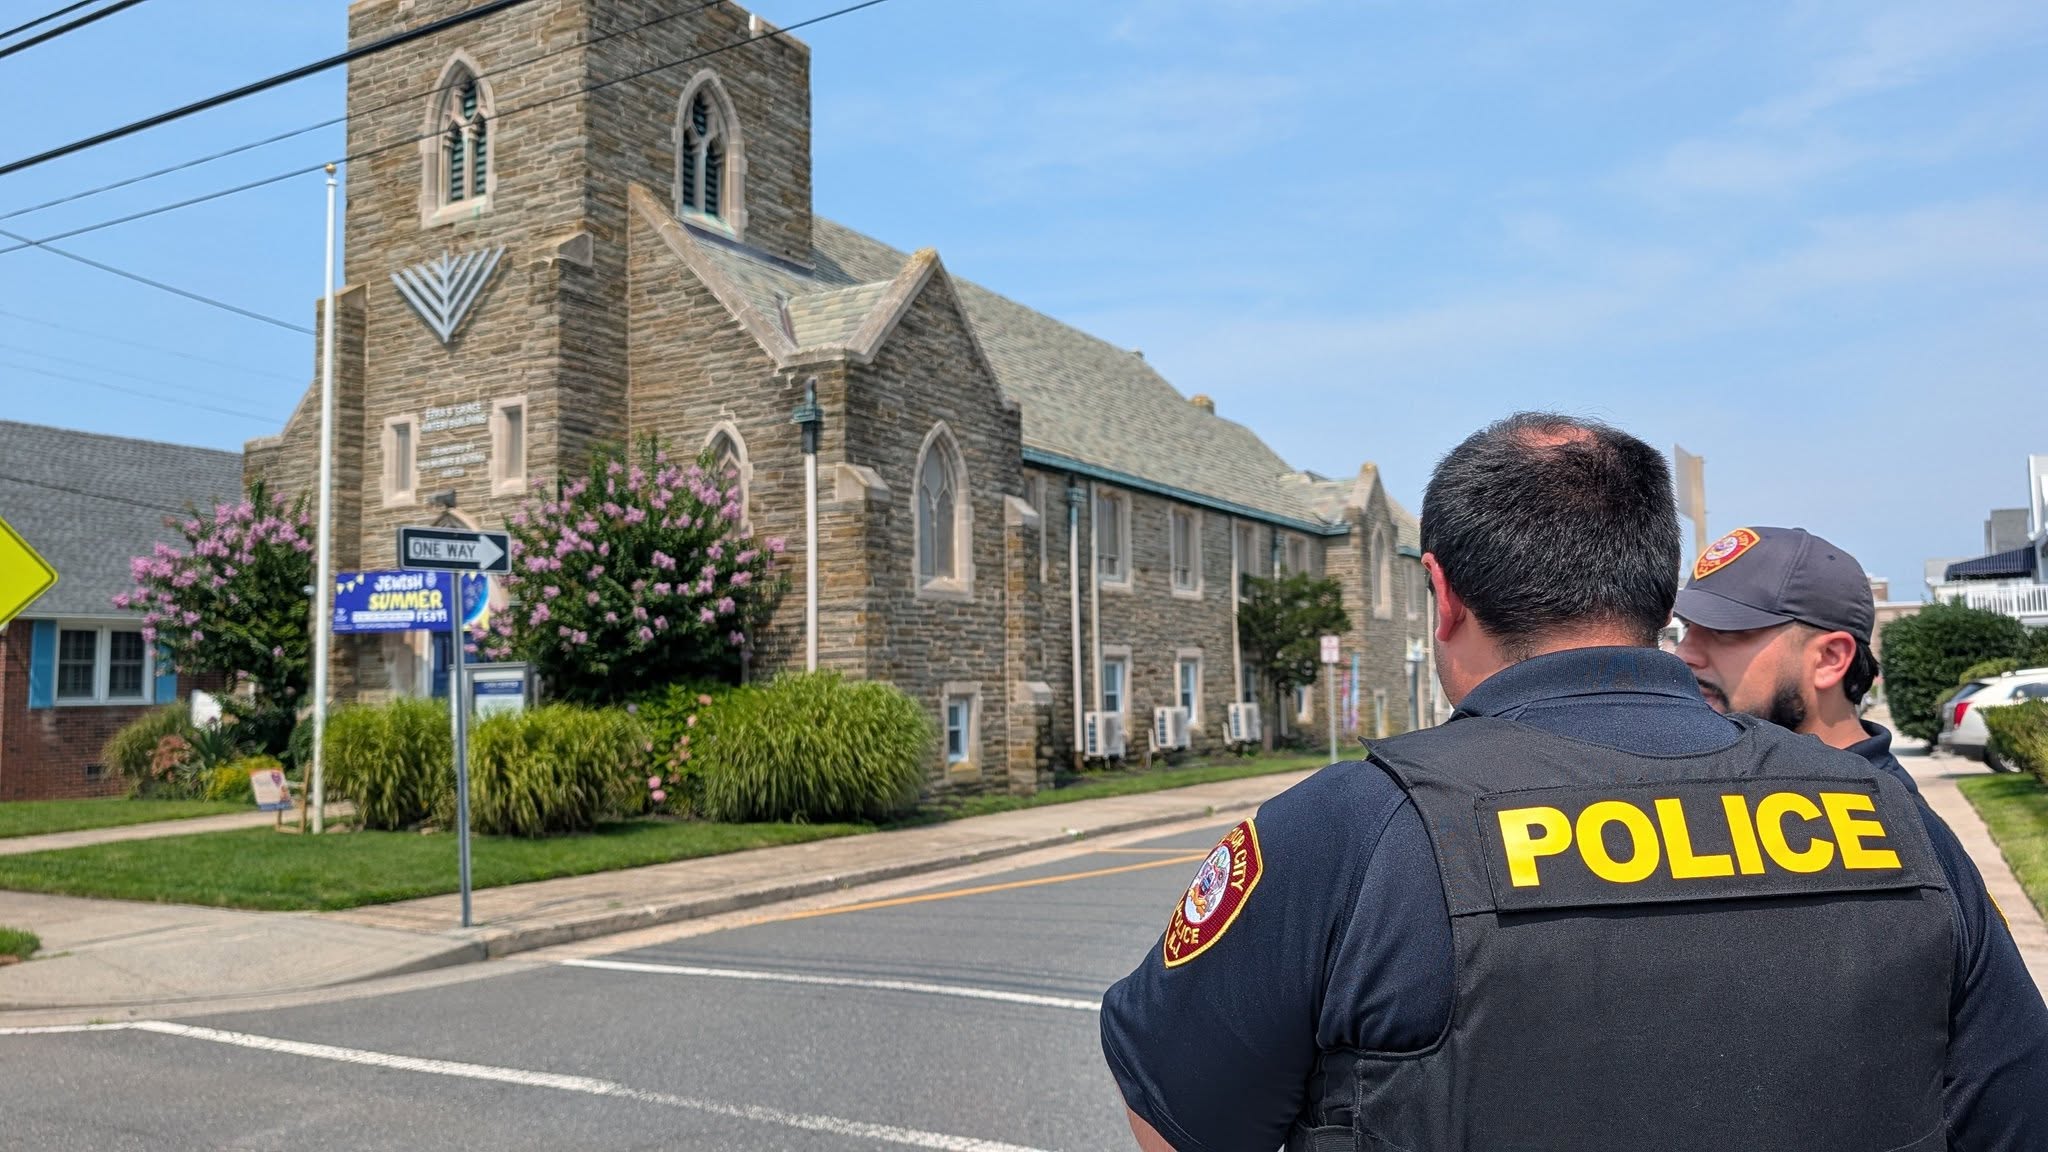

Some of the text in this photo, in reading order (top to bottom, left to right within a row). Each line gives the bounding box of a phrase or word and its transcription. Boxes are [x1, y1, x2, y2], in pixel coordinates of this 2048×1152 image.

[412, 541, 476, 558] ONE WAY
[374, 574, 424, 592] JEWISH
[368, 589, 443, 610] SUMMER
[415, 608, 448, 623] FEST!
[1497, 792, 1903, 888] POLICE
[1230, 848, 1248, 892] CITY
[1174, 899, 1200, 944] POLICE
